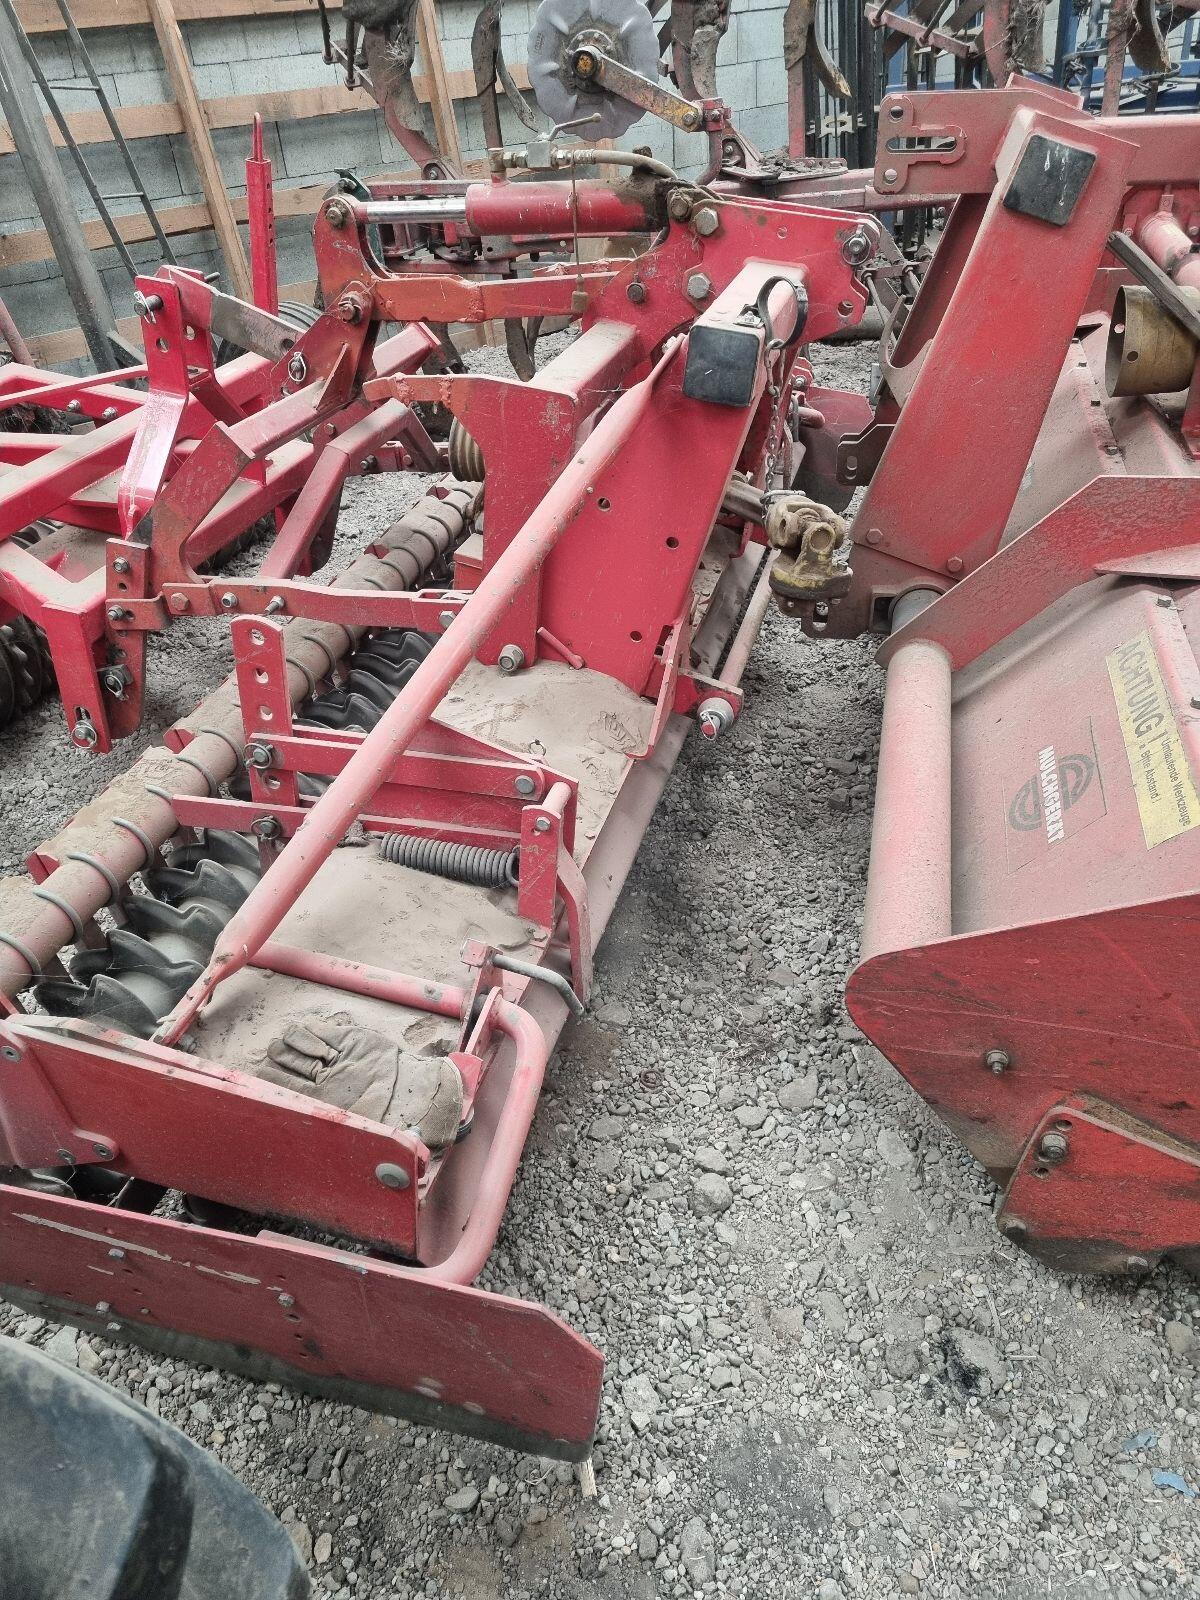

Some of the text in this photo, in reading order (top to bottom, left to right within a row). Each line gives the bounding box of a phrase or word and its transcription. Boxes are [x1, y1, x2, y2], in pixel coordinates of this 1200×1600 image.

[1115, 640, 1165, 738] ACHTUNG
[1140, 749, 1151, 769] Bitte
[1145, 768, 1161, 799] Abstand
[1173, 782, 1192, 827] Werkzeuge
